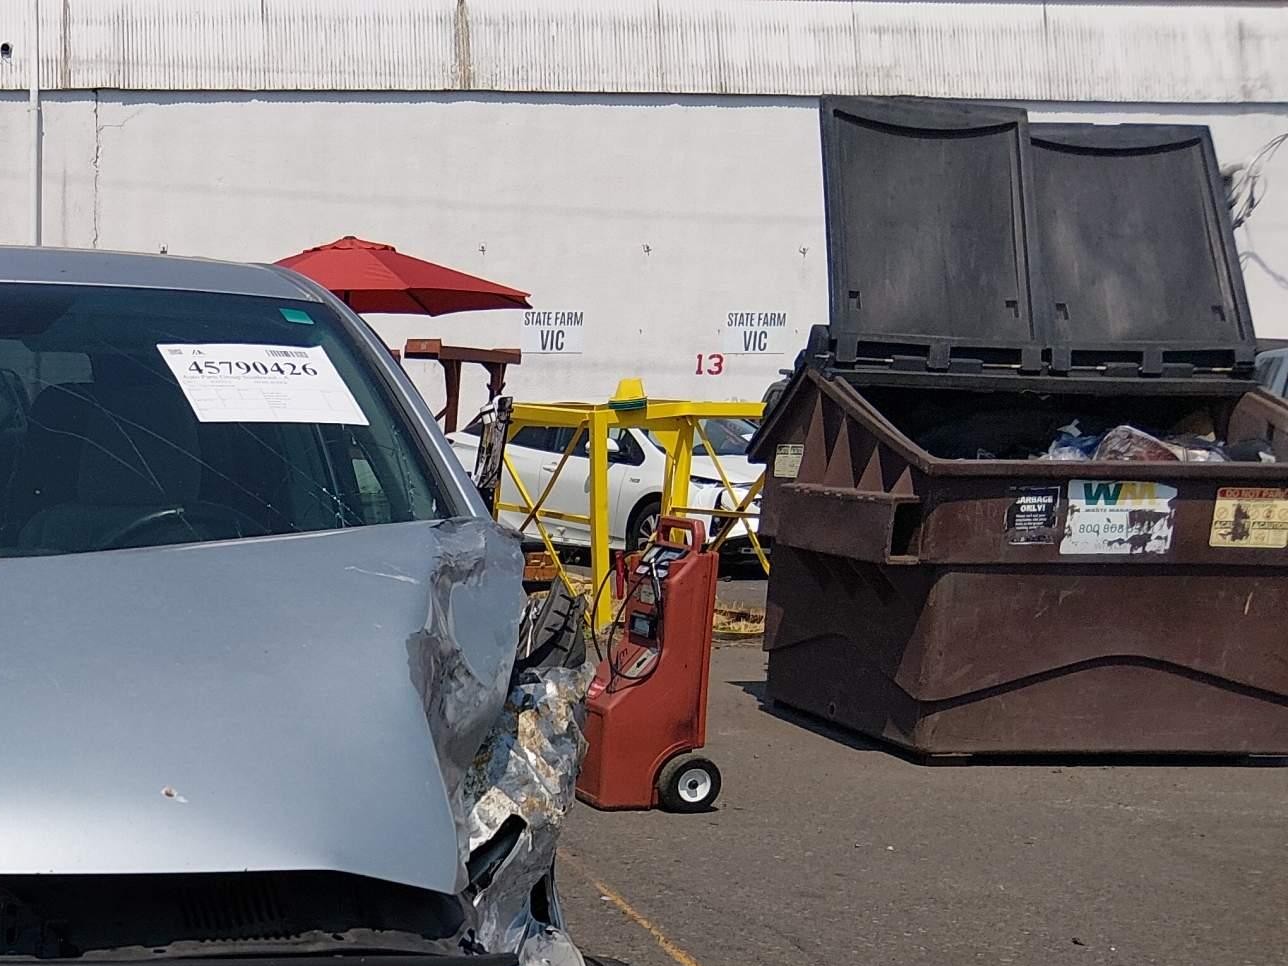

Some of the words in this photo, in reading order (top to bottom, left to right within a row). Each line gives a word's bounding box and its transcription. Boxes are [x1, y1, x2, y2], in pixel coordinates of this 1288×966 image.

[524, 311, 553, 327] STATE
[554, 311, 584, 327] FARM
[727, 312, 756, 327] STATE
[757, 312, 787, 327] FARM
[540, 329, 565, 351] VIC
[742, 330, 768, 352] VIC
[188, 360, 319, 377] 45790426
[695, 353, 724, 375] 13
[1083, 482, 1158, 506] WM
